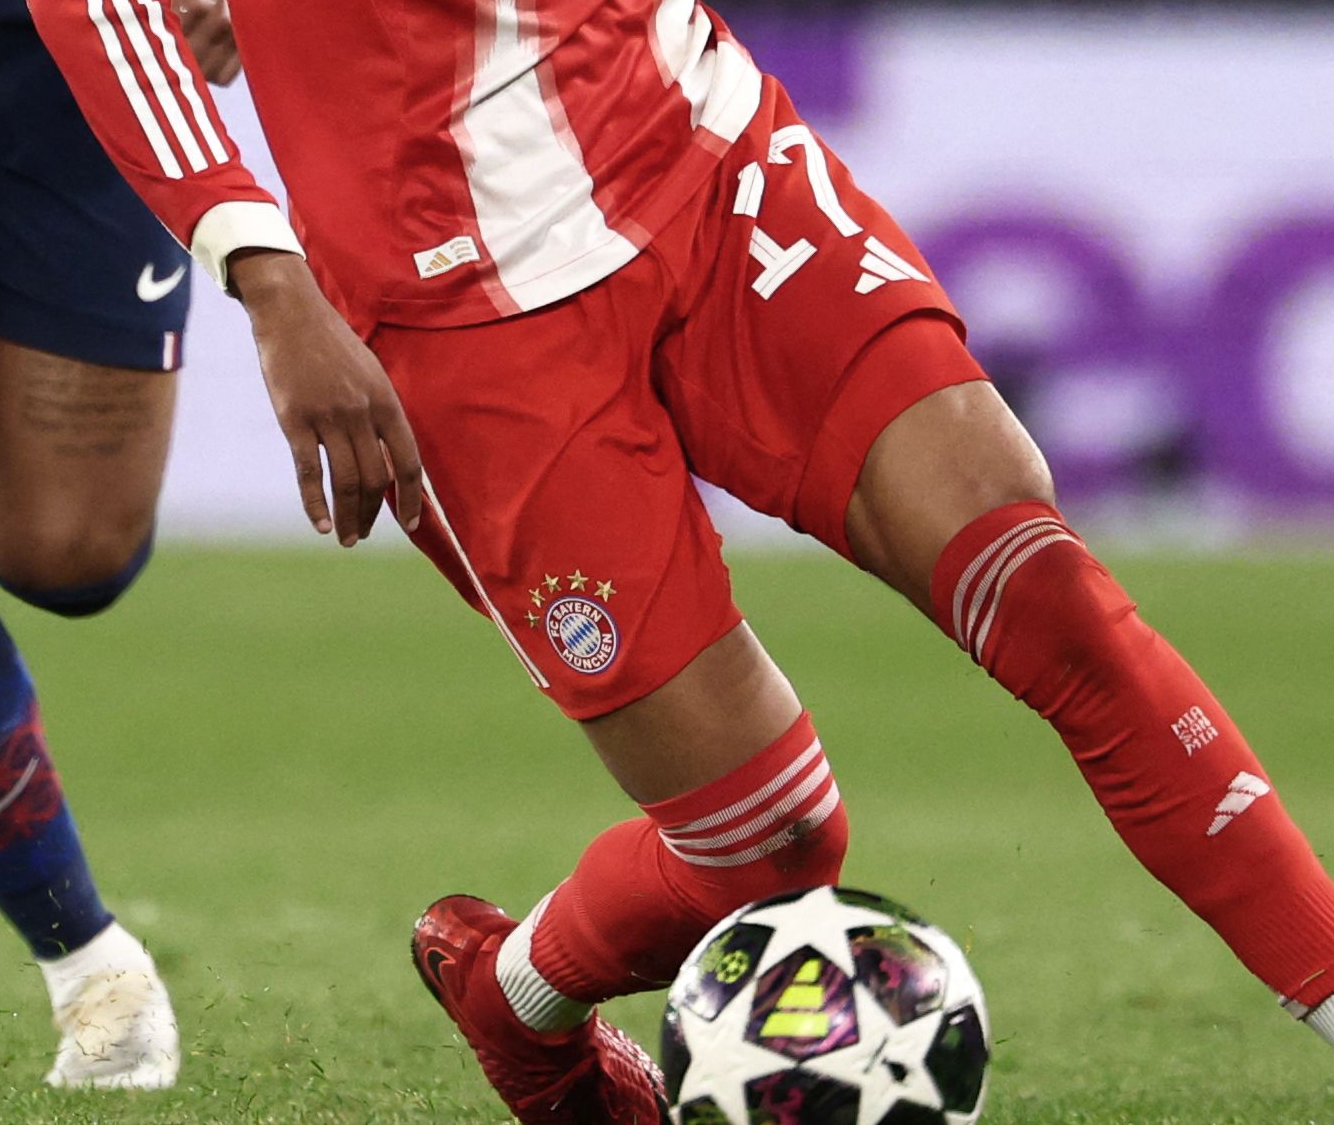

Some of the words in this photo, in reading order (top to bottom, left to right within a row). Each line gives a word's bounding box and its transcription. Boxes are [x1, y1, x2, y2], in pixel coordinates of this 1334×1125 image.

[732, 124, 863, 300] 17
[552, 602, 602, 623] BAYERN
[549, 620, 560, 638] FC
[1170, 705, 1204, 735] MIA
[1184, 726, 1219, 757] MIA
